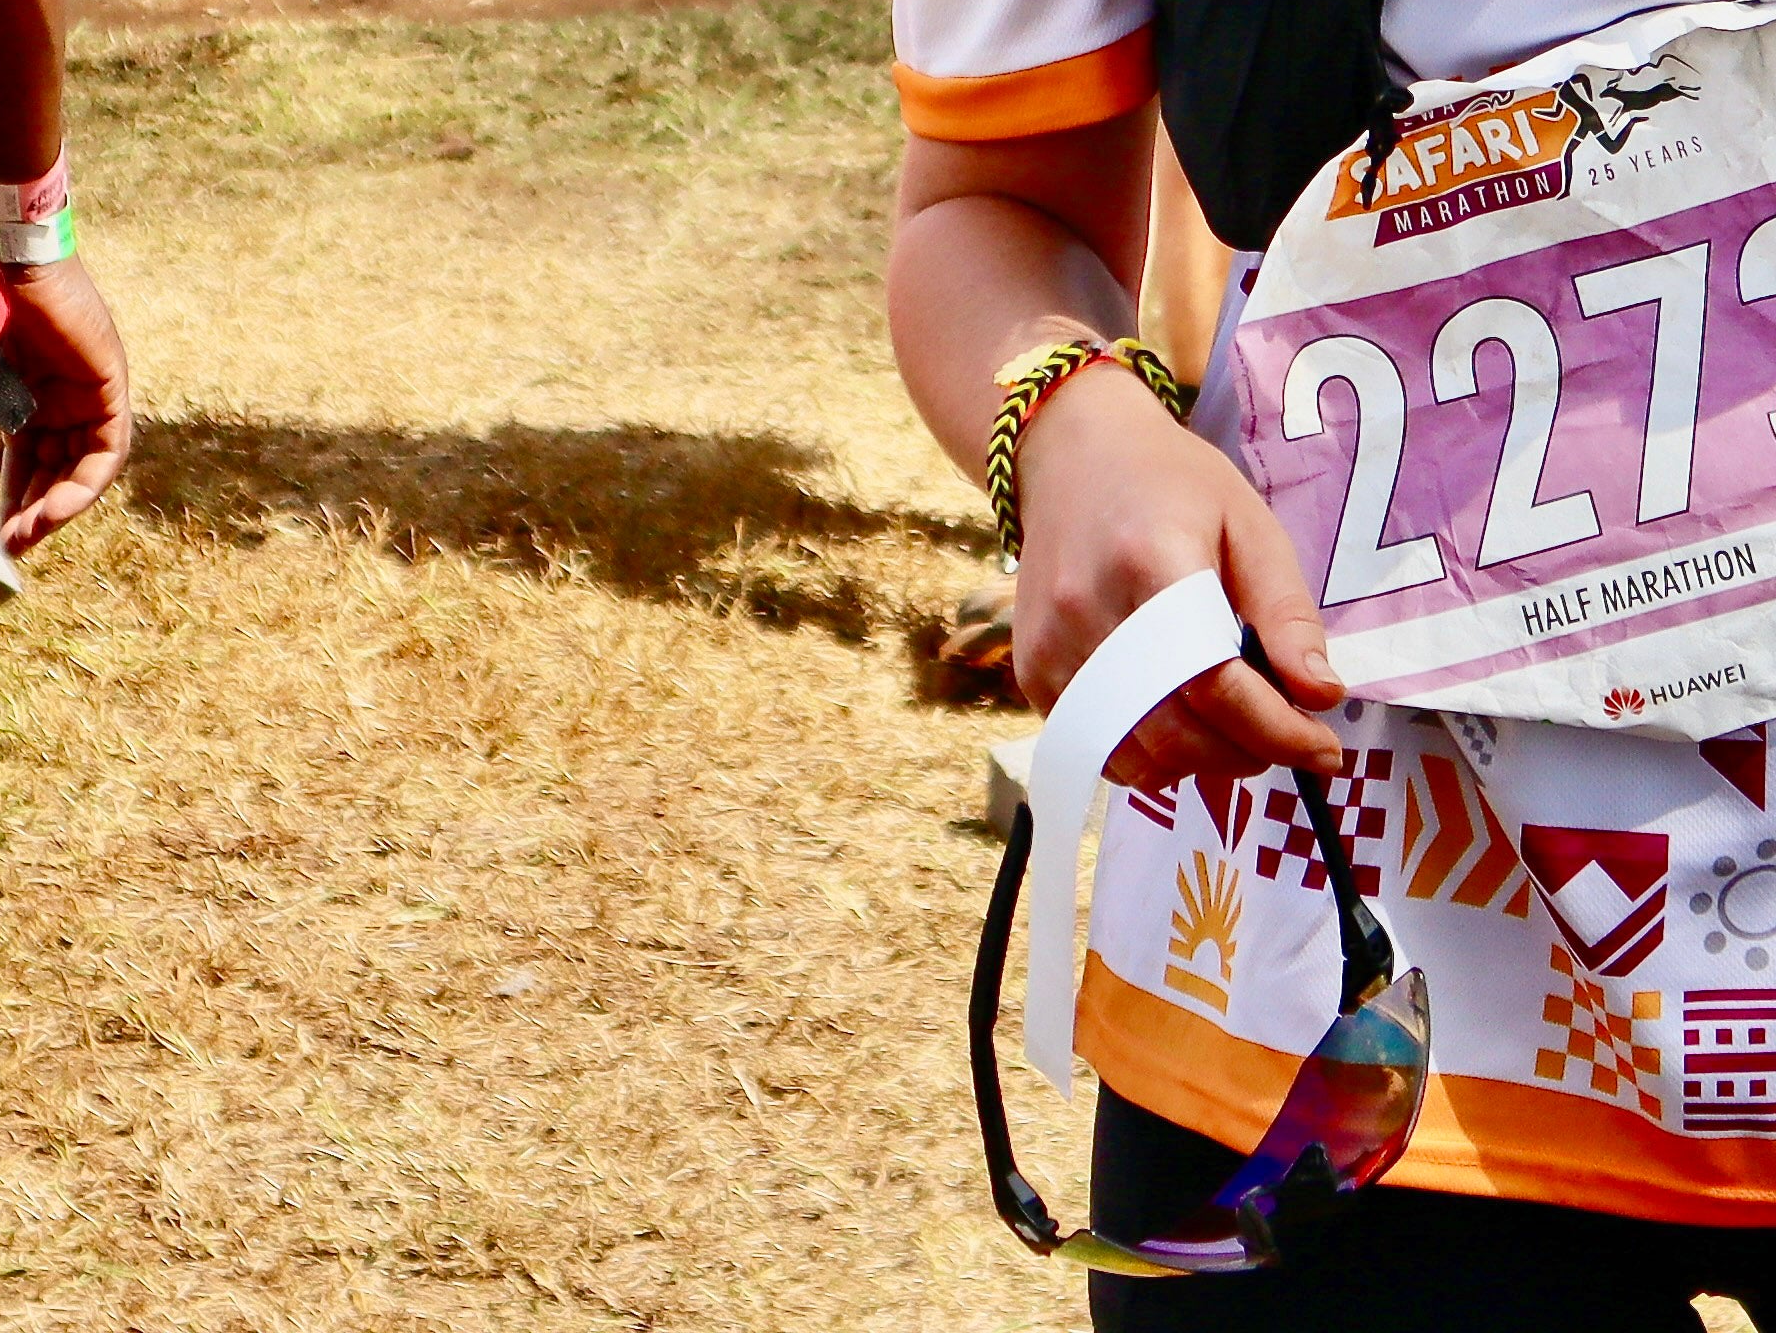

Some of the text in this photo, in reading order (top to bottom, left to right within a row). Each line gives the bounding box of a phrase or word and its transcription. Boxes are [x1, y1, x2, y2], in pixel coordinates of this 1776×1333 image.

[1349, 110, 1541, 205] SAFARI
[1587, 134, 1704, 187] 25 YEARS
[1392, 170, 1551, 234] MARATHON
[1521, 543, 1758, 638] HALF MARATHON
[1649, 663, 1747, 706] HUAWEI
